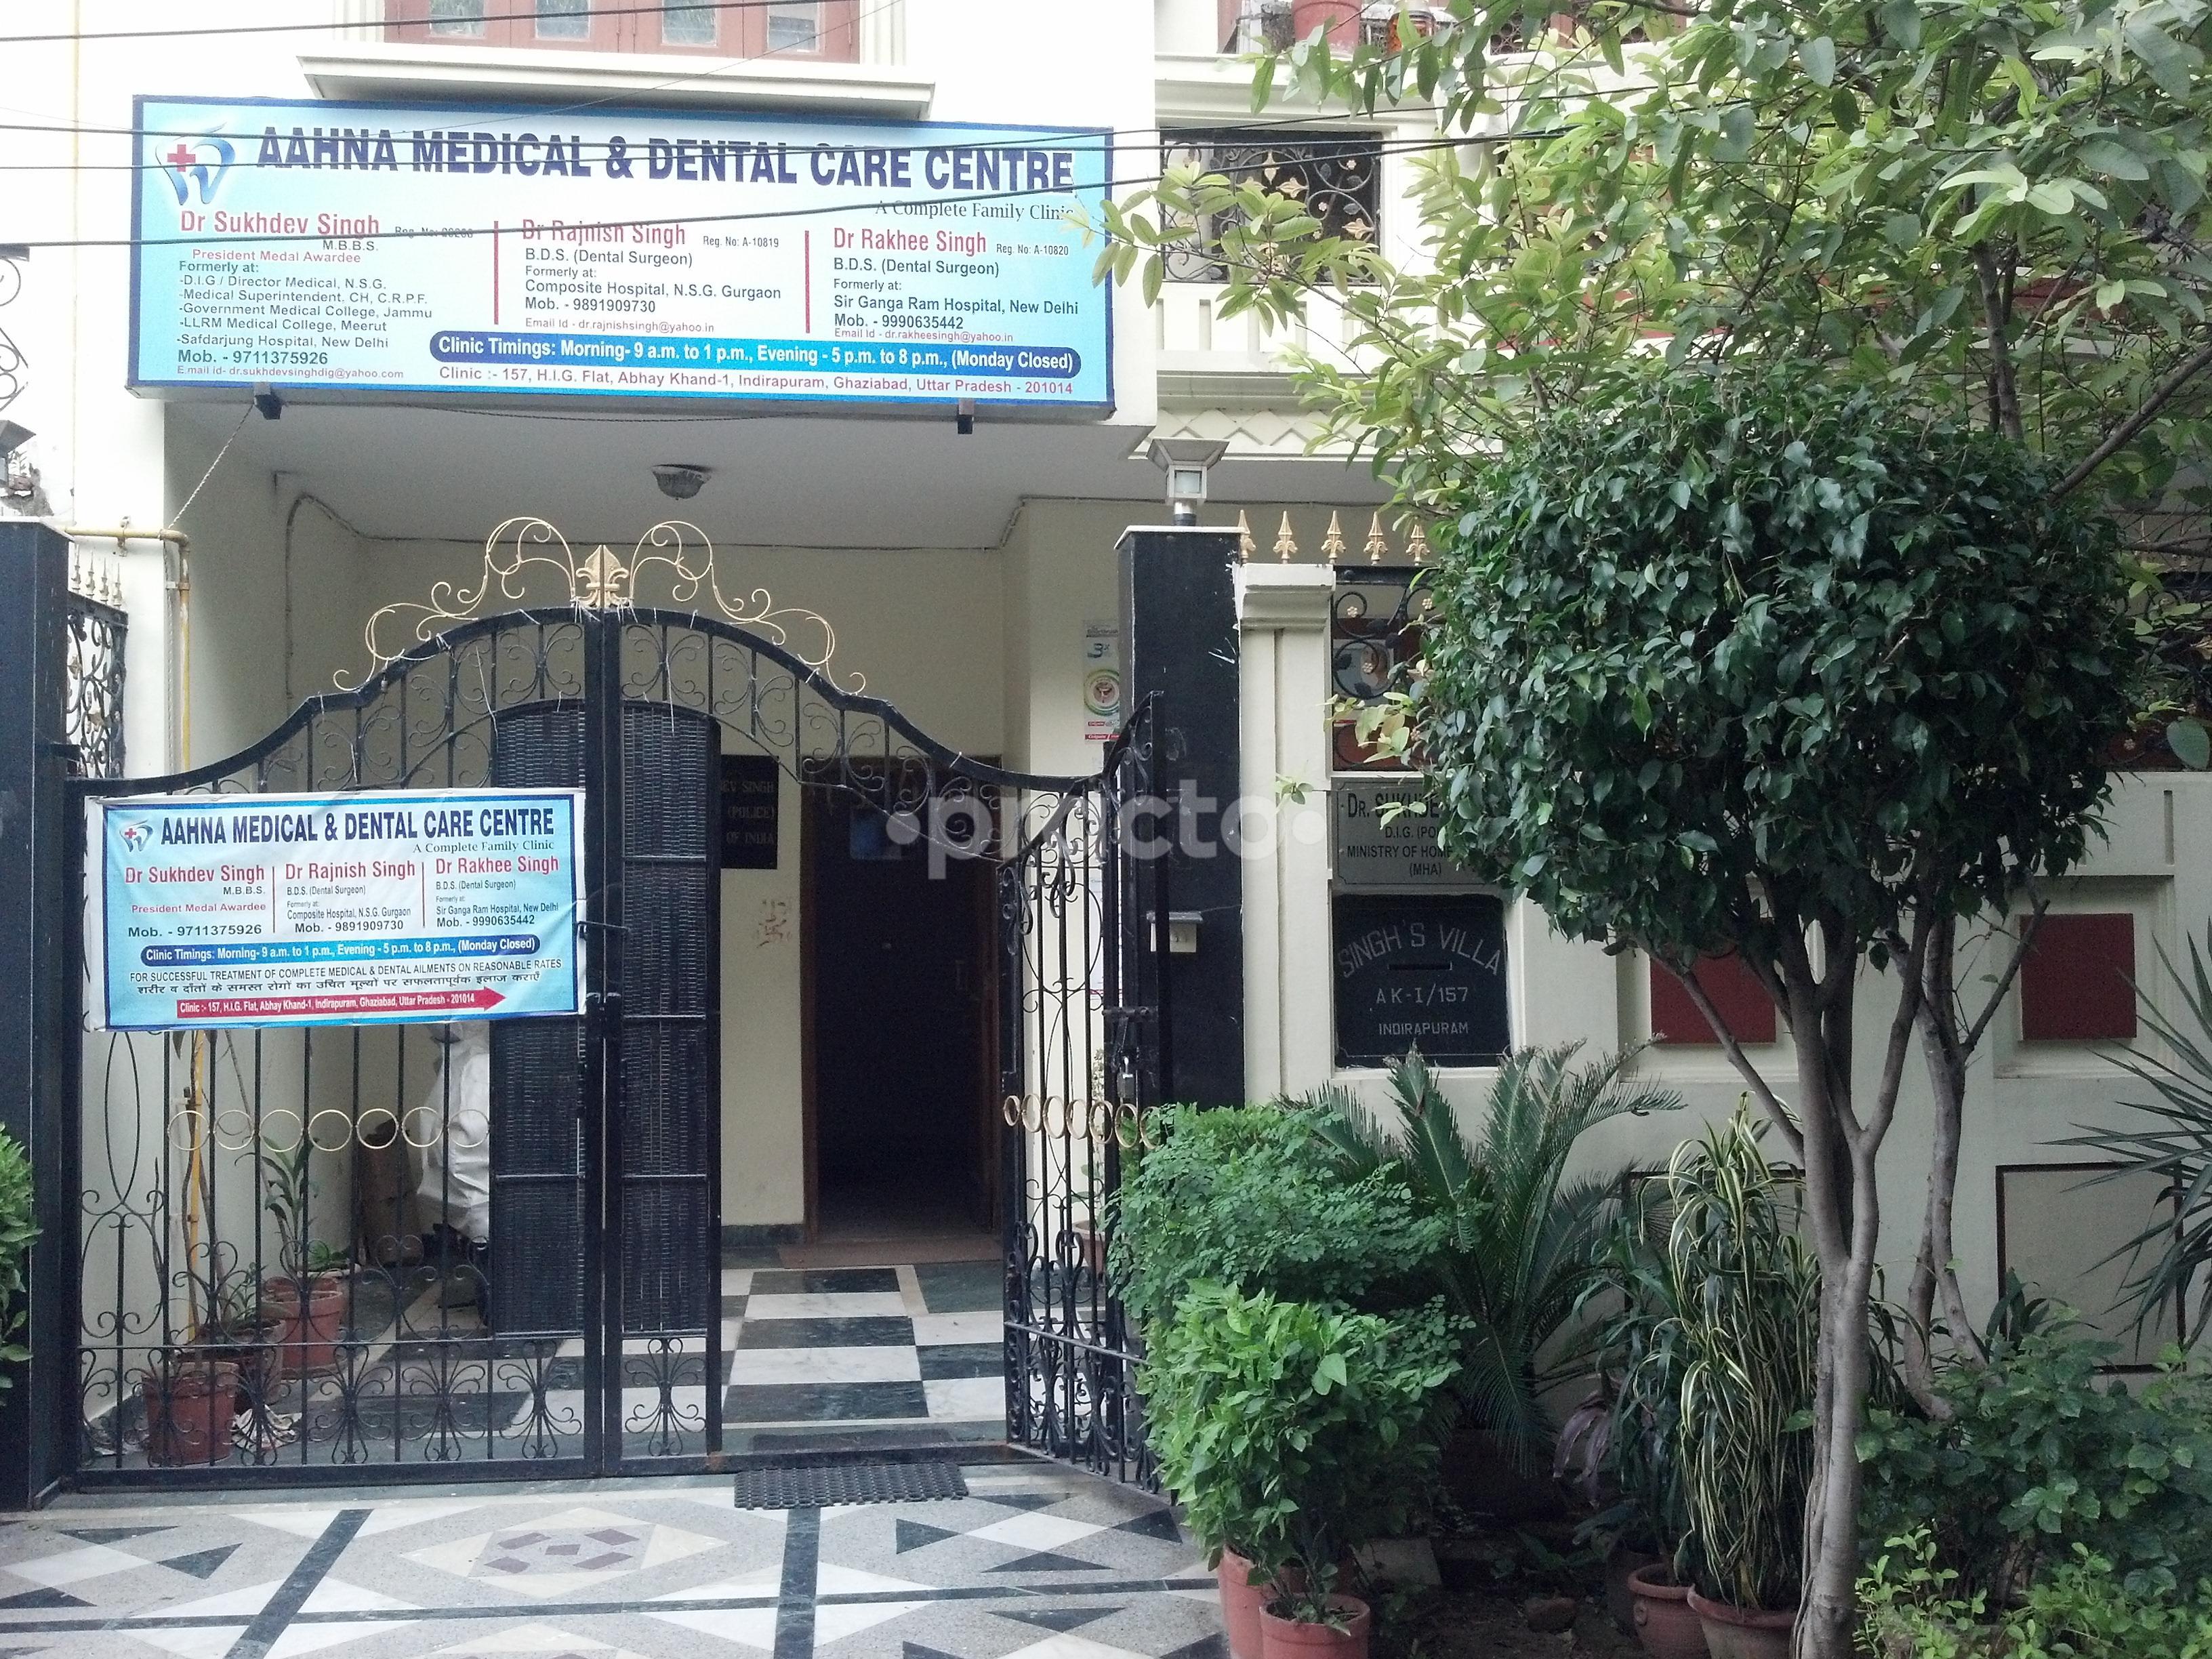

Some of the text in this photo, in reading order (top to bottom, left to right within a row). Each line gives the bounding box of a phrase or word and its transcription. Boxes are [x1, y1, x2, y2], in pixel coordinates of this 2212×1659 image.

[257, 126, 1074, 193] AAHNA MEDICAL & DENTAL CARE CENTRE
[893, 201, 967, 219] Complete
[972, 203, 1024, 222] Family
[181, 211, 205, 231] Dr
[214, 211, 308, 233] Sukhdev
[317, 213, 380, 239] Singh
[523, 219, 685, 249] Dr Rajnish Singh
[323, 240, 378, 251] M.B.B.S.
[703, 237, 779, 247] Reg. No: A-10819
[834, 228, 987, 257] Dr Rakhee Singh
[996, 244, 1069, 255] Reg. No: A-10820
[192, 249, 361, 262] President Medal Awardee
[525, 248, 693, 268] B.D.S. (Dental Surgeon)
[834, 258, 1000, 277] B.D.S. (Dental Surgeon)
[378, 293, 427, 304] C.R.P.F.
[525, 279, 781, 301] Composite Hospital, N.S.G. Gurgaon
[270, 305, 320, 316] Medical
[326, 306, 379, 318] College,
[384, 308, 432, 319] Jammu
[525, 297, 655, 313] Mob. 9891909730
[834, 295, 1078, 315] Sir Ganga Ram Hospital, New Delhi
[227, 318, 277, 329] Medical
[283, 319, 336, 332] College,
[341, 321, 386, 331] Meerut
[834, 314, 964, 329] Mob. 9990635442
[258, 335, 316, 348] Hospital,
[322, 337, 350, 348] New
[355, 337, 388, 348] Delhi
[178, 350, 328, 364] Mob. 9711375926
[438, 337, 1073, 373] Clinic Timings: Morning- 9 a.m. to 1 p.m., Evening 5 p.m. to 8 p.m., (Monday Closed)
[440, 367, 482, 380] Clinic
[503, 369, 531, 383] 157,
[537, 369, 577, 382] H.I.G.
[582, 371, 613, 384] Flat,
[618, 371, 663, 387] Abhay
[670, 373, 734, 387] Khand-1,
[834, 377, 912, 392] Ghaziabad,
[916, 379, 950, 392] Uttar
[955, 380, 1011, 392] Pradesh
[1025, 382, 1072, 394] 201014
[161, 808, 554, 845] AAHNA MEDICAL & DENTAL CARE CENTRE
[1385, 827, 1413, 838] D.I.G.
[413, 840, 554, 853] A Complete Family Clinic
[1347, 846, 1399, 857] MINISTRY
[1403, 846, 1420, 857] OF
[286, 860, 415, 882] Dr Rajnish Singh
[436, 855, 558, 874] Dr Rakhee Singh
[1410, 863, 1441, 876] (MHA)
[125, 865, 264, 884] Dr Sukhdev Singh
[1439, 924, 1501, 976] VILLA
[130, 959, 561, 982] FOR SUCCESSFUL TREATMENT OF COMPLETE MEDICAL & DENTAL AILMENTS ON REASONABLE RATES
[138, 984, 165, 994] शरीर
[211, 983, 222, 992] के
[227, 983, 262, 991] समस्त
[316, 979, 345, 989] उचित
[476, 975, 507, 984] इलाज
[1379, 1022, 1469, 1036] INDIRAPURAM
